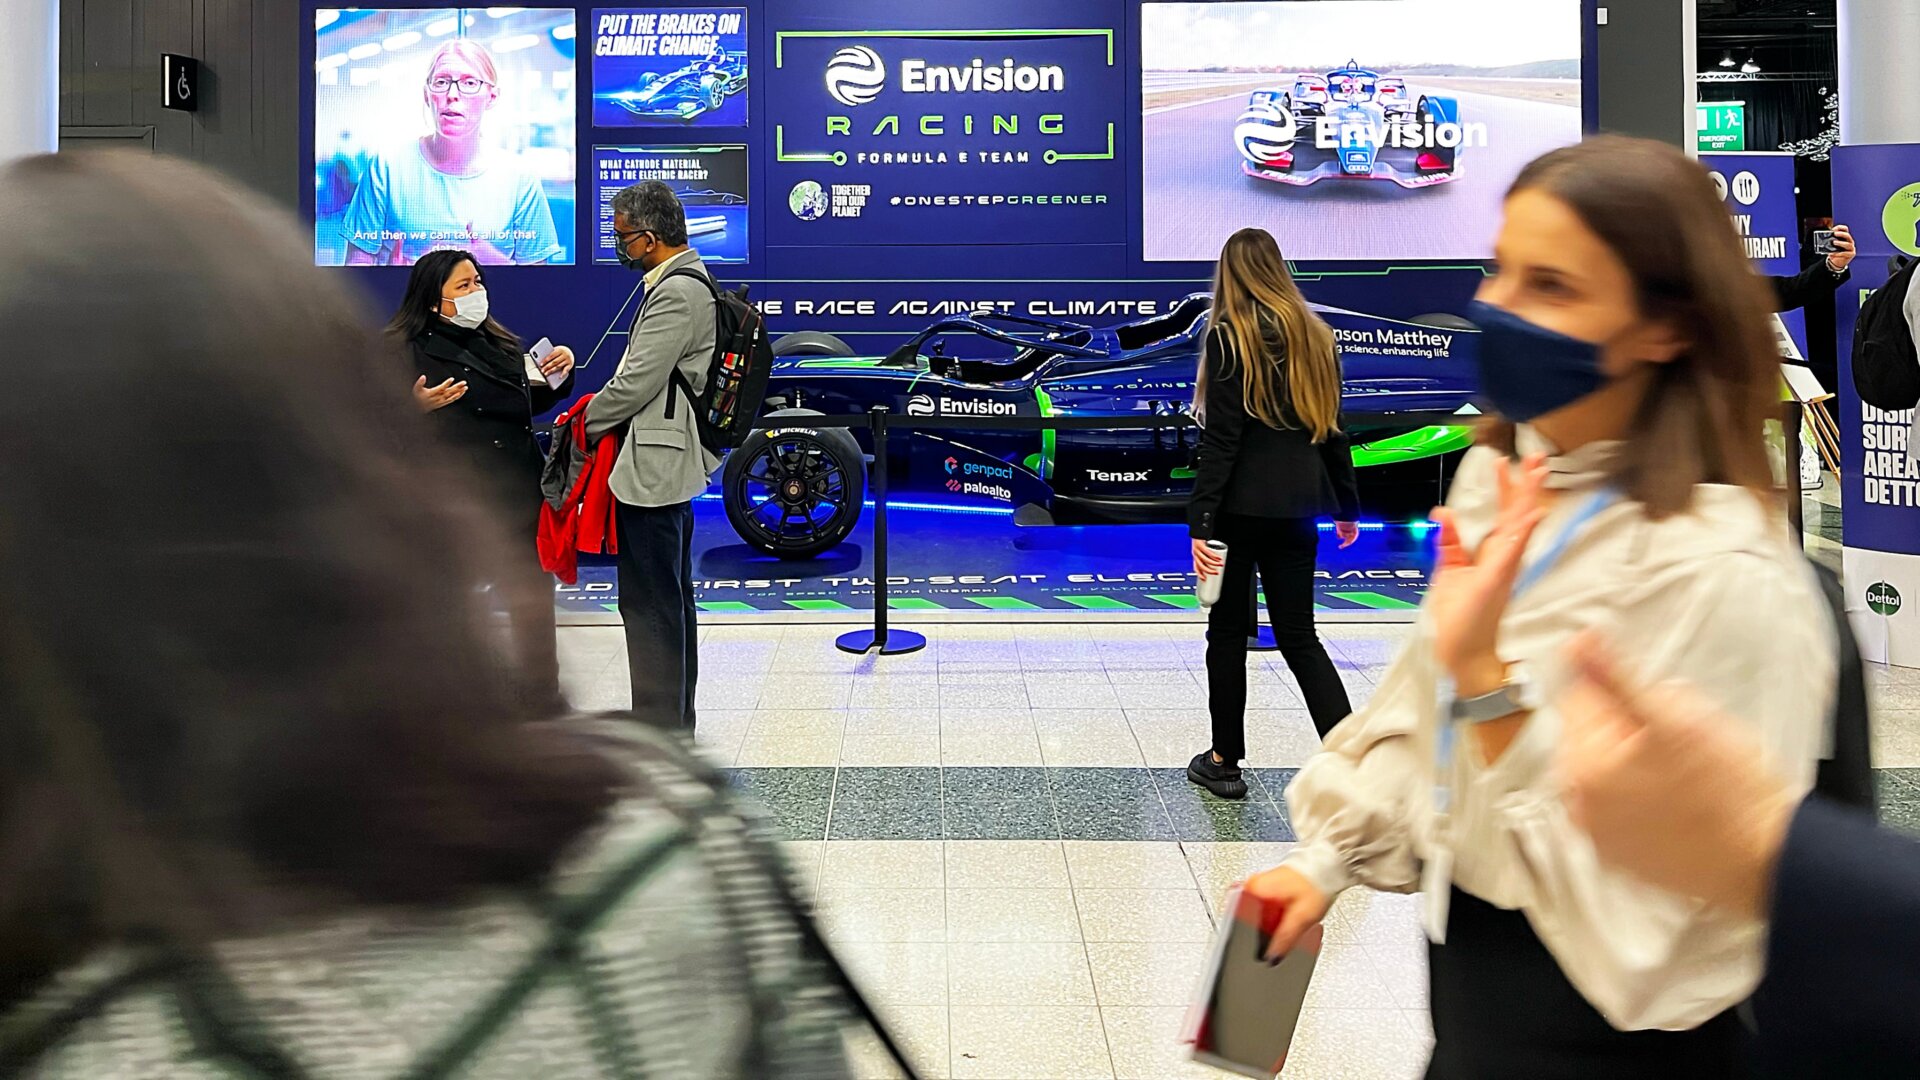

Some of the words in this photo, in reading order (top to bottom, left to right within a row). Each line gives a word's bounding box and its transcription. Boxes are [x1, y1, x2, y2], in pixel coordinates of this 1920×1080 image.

[598, 14, 629, 35] PUT
[630, 14, 657, 35] THE
[657, 14, 716, 35] BRAKES
[717, 13, 741, 35] ON
[595, 35, 659, 56] CLIMATE
[658, 35, 720, 57] CHANGE
[901, 58, 1065, 92] Envision
[826, 114, 1064, 135] RACING
[1315, 114, 1488, 149] Envision
[600, 159, 622, 169] WHAT
[624, 159, 660, 169] CATHODE
[662, 159, 701, 169] MATERIAL
[857, 152, 947, 164] FORMULA
[958, 152, 968, 163] E
[979, 152, 1029, 163] TEAM
[600, 170, 608, 180] IS
[611, 170, 620, 180] IN
[622, 170, 637, 180] THE
[639, 170, 676, 180] ELECTRIC
[678, 170, 709, 180] RACER?
[831, 184, 871, 196] TOGETHER
[832, 196, 848, 206] FOR
[848, 196, 866, 206] OUR
[890, 195, 1108, 206] #ONESTEPGREENER
[832, 207, 861, 217] PLANET
[354, 230, 378, 240] And
[381, 230, 407, 240] then
[411, 232, 426, 240] we
[430, 231, 450, 240] can
[454, 230, 479, 240] take
[483, 230, 495, 240] all
[498, 230, 510, 240] of
[514, 230, 537, 240] that
[1743, 237, 1786, 258] URANT
[755, 301, 783, 315] HE
[795, 301, 875, 315] RACE
[888, 301, 1015, 315] AGAINST
[1028, 301, 1156, 315] CLIMATE
[1333, 328, 1373, 343] nson
[1377, 328, 1452, 349] Matthey
[1384, 347, 1432, 358] enhancing
[1434, 348, 1449, 357] life
[940, 397, 1017, 415] Envision
[780, 427, 818, 436] MICHELIN
[963, 463, 1013, 479] genpact
[1086, 469, 1148, 482] Tenax
[963, 482, 1012, 499] paloalto
[822, 575, 1046, 587] TWO-SEAT
[1313, 570, 1424, 579] RACE
[1867, 592, 1900, 606] Dettol
